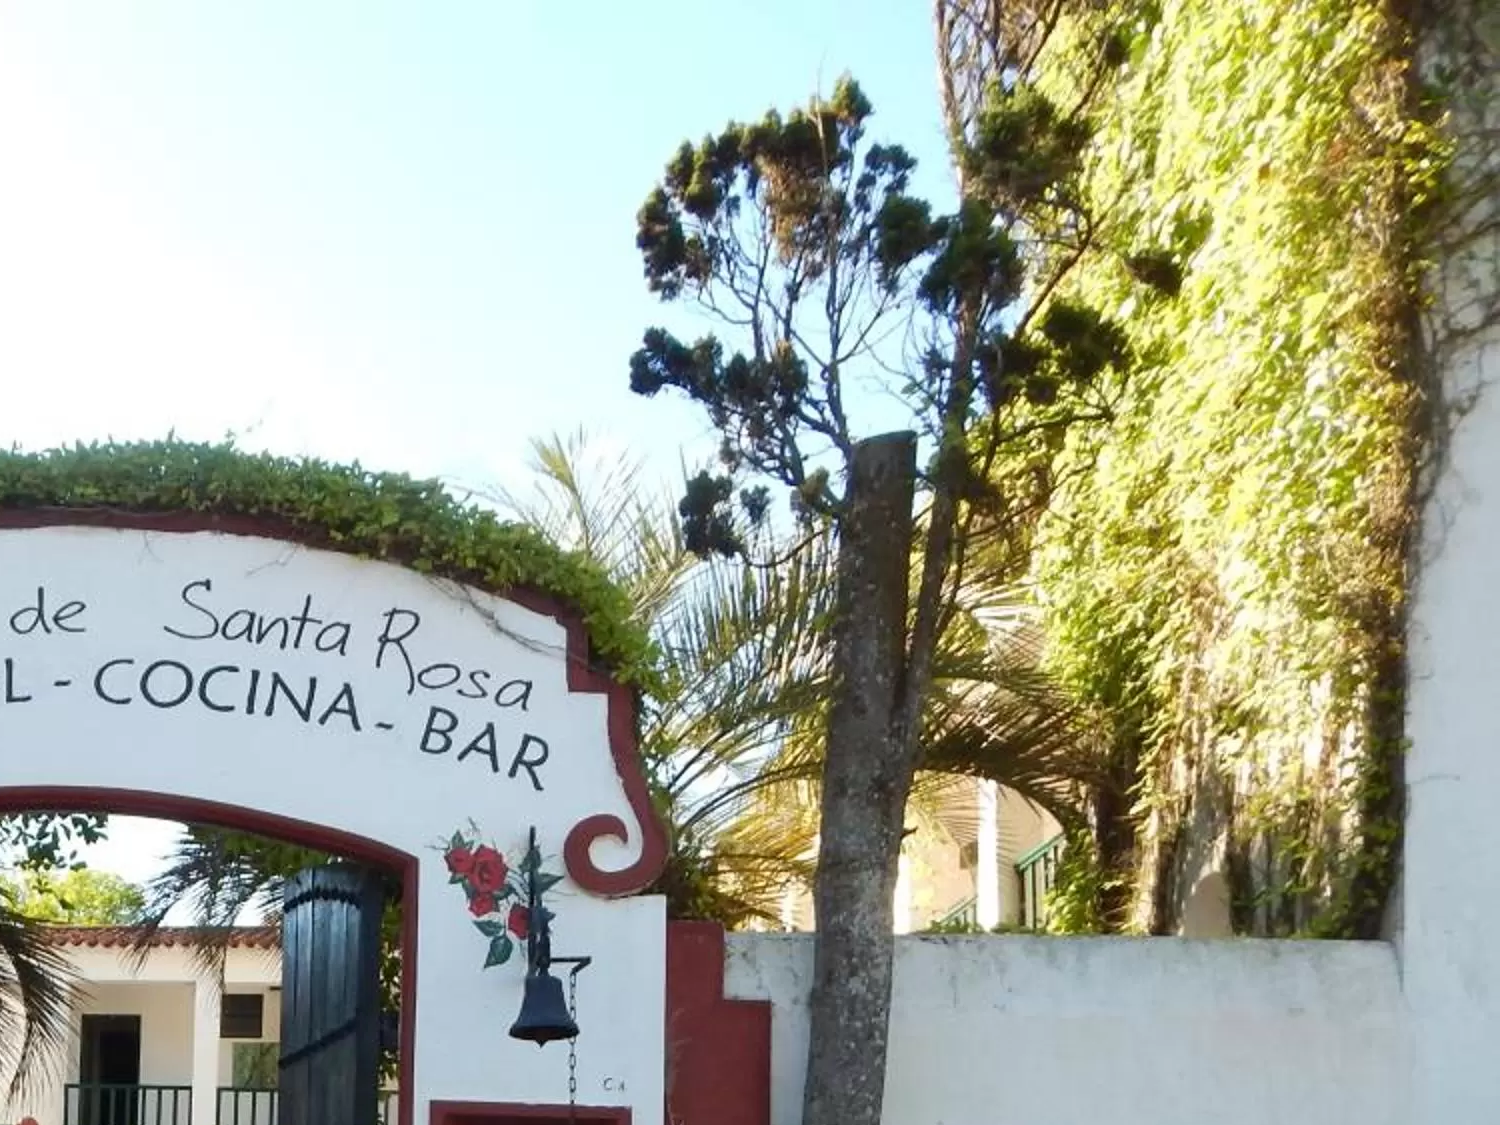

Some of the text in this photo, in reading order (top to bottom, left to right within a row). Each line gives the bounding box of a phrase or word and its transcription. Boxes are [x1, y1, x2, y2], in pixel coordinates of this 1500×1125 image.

[9, 586, 87, 635] de
[162, 578, 353, 657] Santa
[374, 607, 534, 712] Rosa
[93, 657, 362, 733] COCINA
[417, 705, 551, 792] BAR
